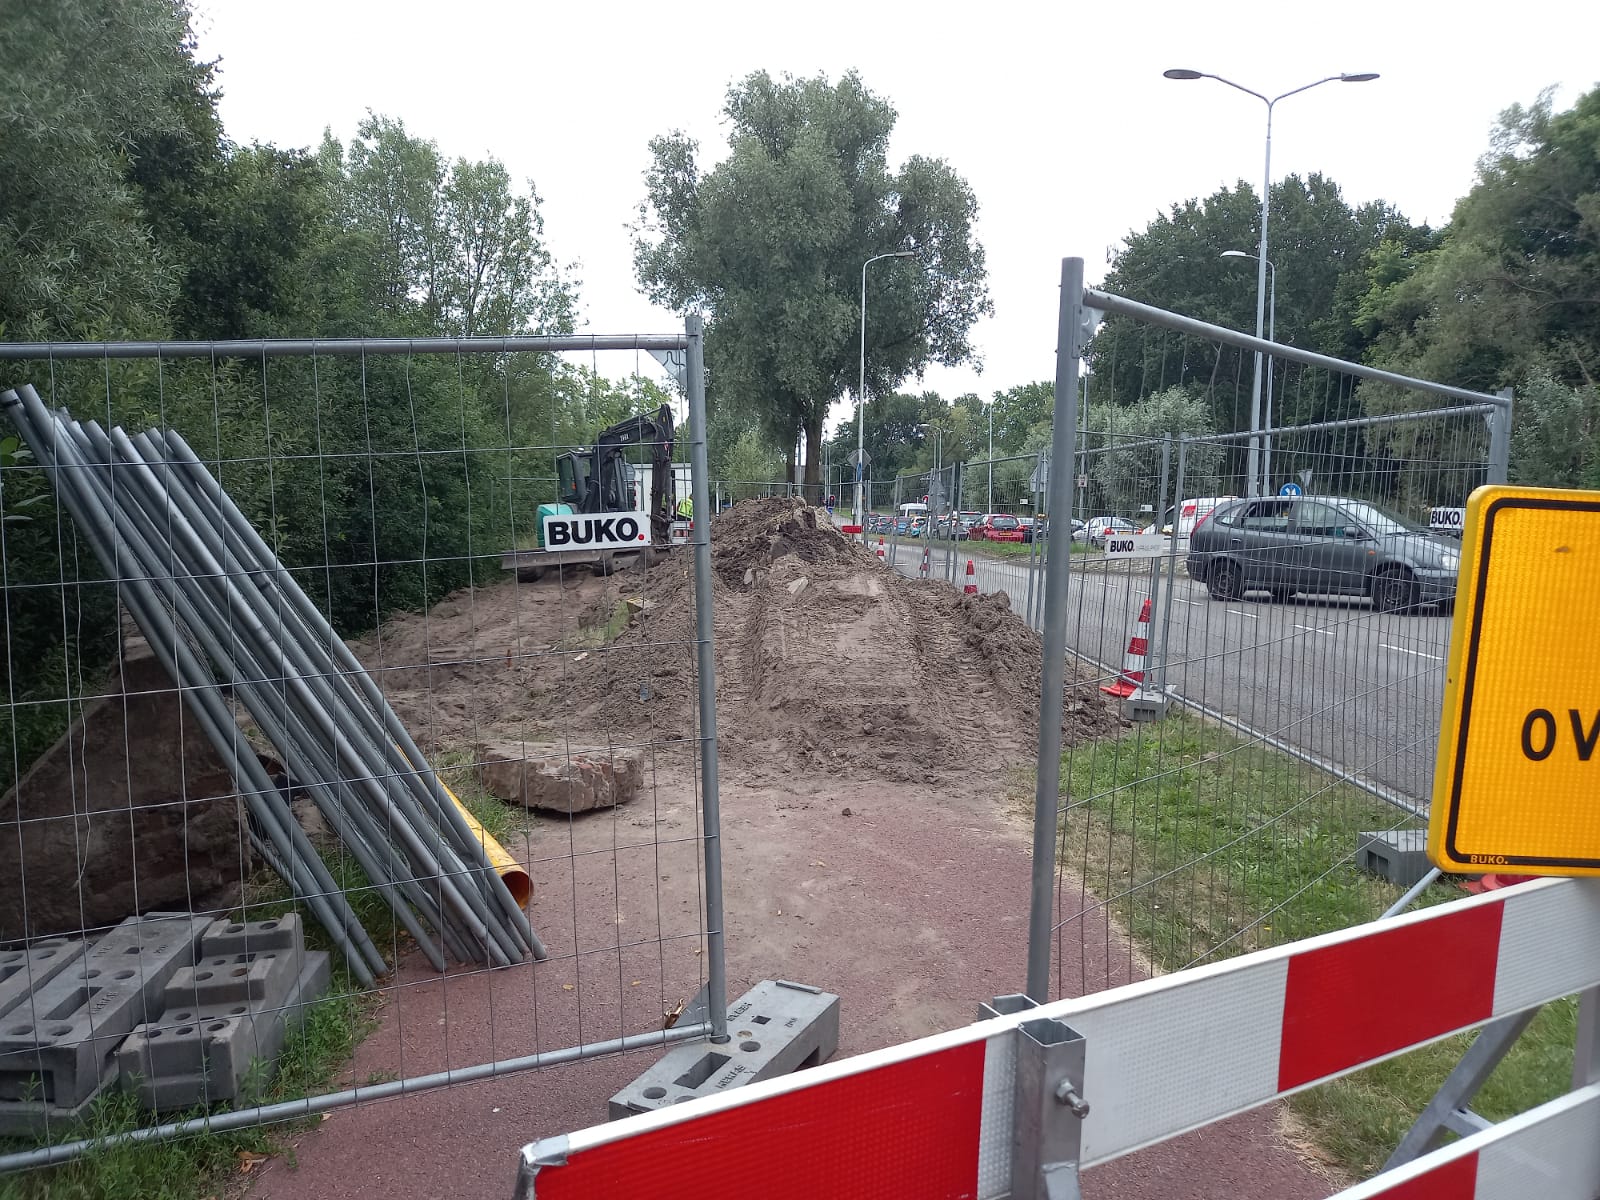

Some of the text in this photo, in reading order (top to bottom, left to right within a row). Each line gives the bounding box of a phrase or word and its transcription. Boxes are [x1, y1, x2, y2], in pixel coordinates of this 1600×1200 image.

[1430, 510, 1462, 526] BUKO.
[548, 517, 645, 545] BUKO.
[1110, 540, 1135, 552] BUKO.
[1521, 708, 1600, 761] OV
[1470, 854, 1509, 865] BUKO.
